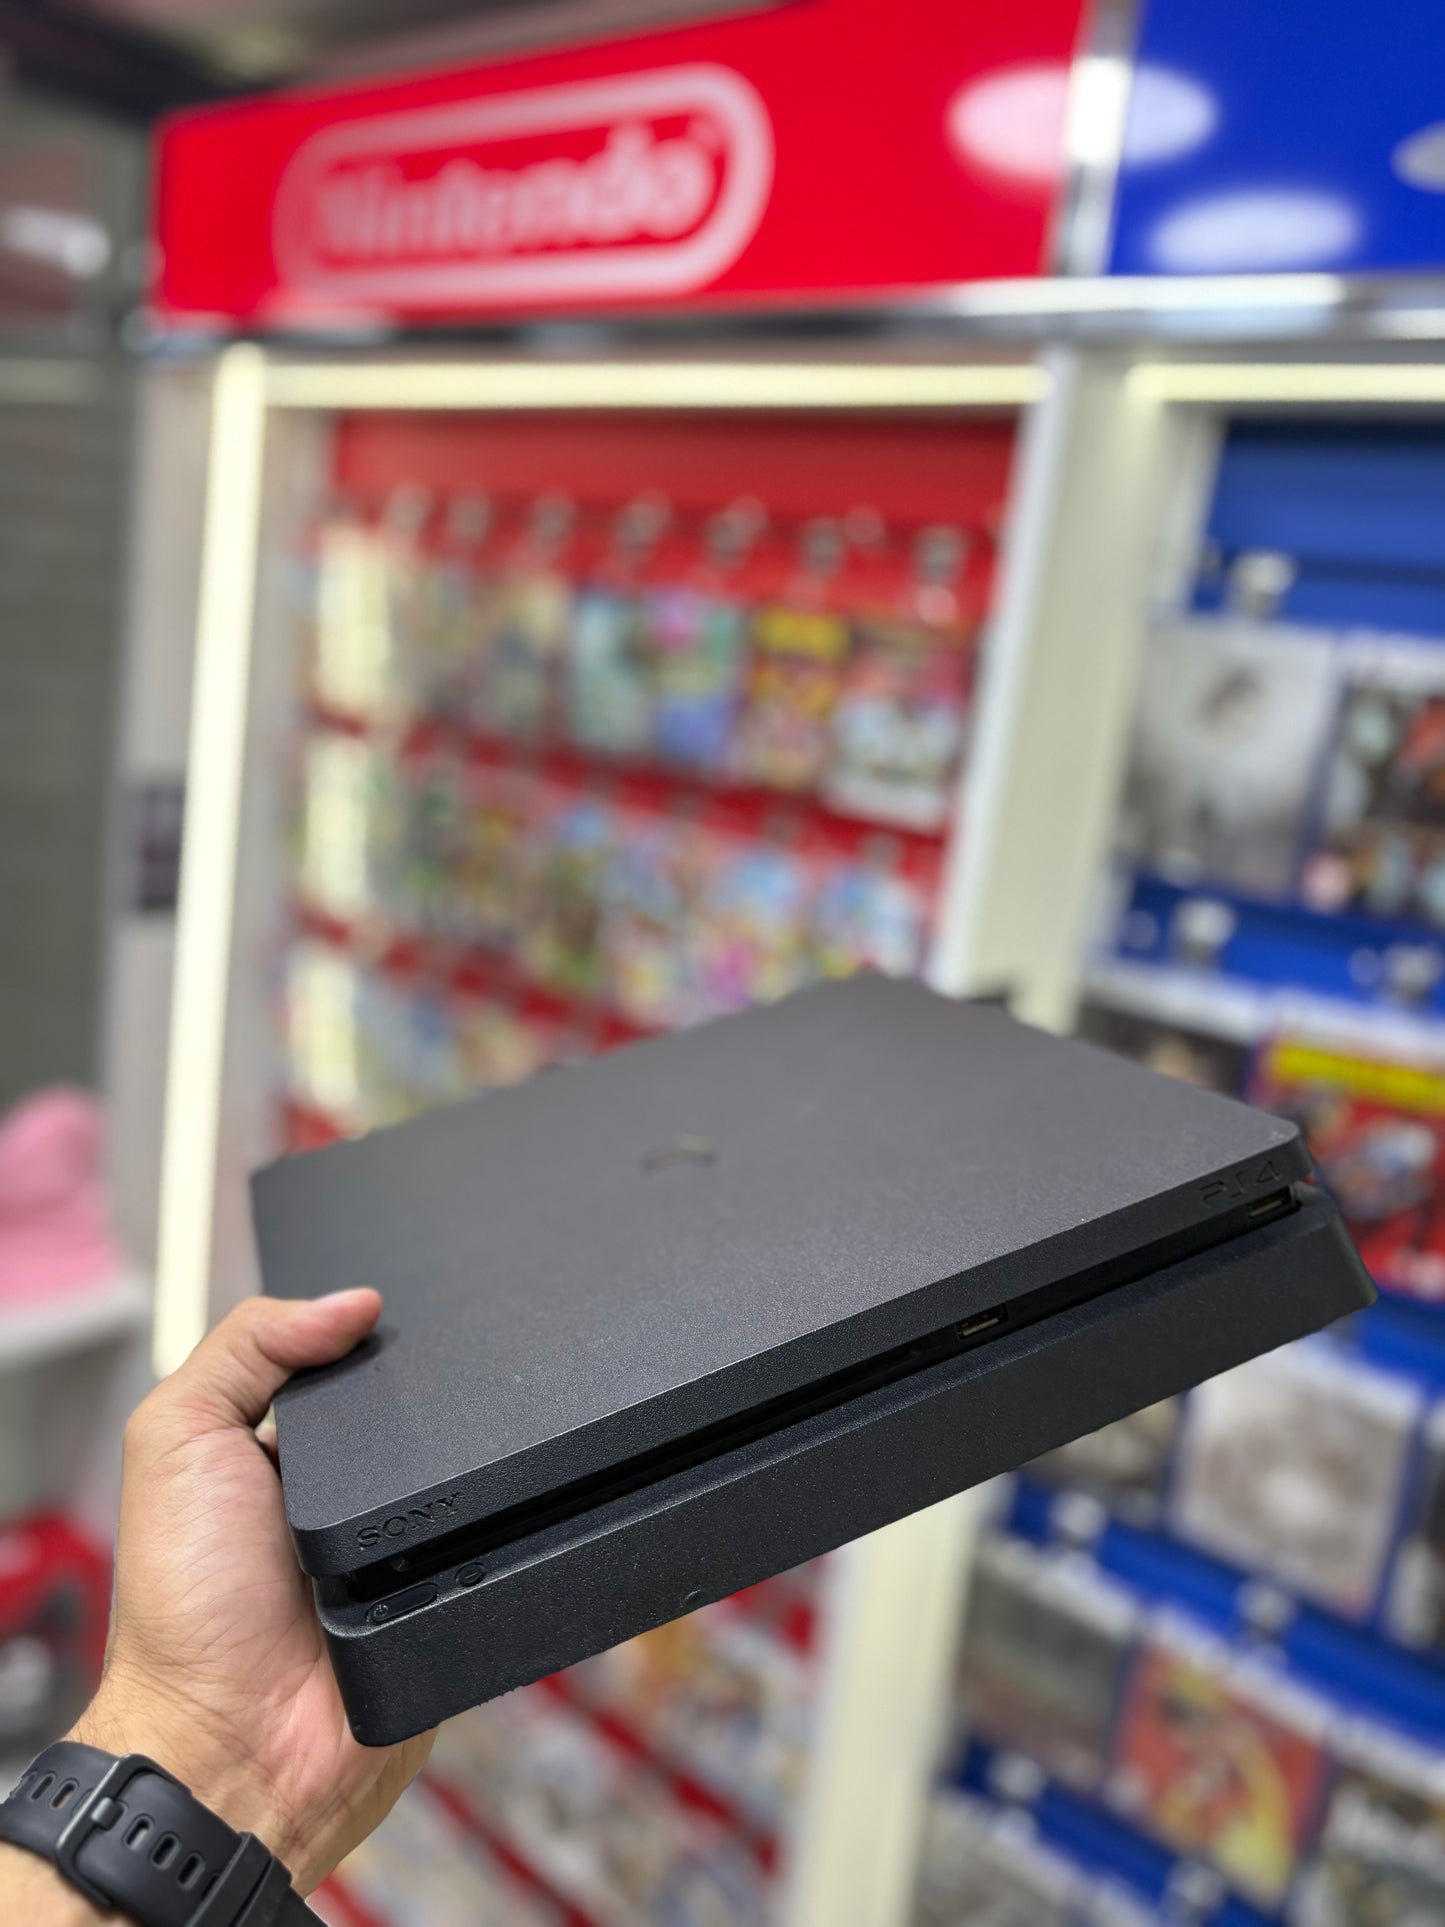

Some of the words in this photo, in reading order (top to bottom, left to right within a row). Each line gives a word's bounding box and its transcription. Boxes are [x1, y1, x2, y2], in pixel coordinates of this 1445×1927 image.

[316, 117, 715, 258] Nintendo
[1198, 1160, 1280, 1208] PS4
[356, 1491, 460, 1549] SONY
